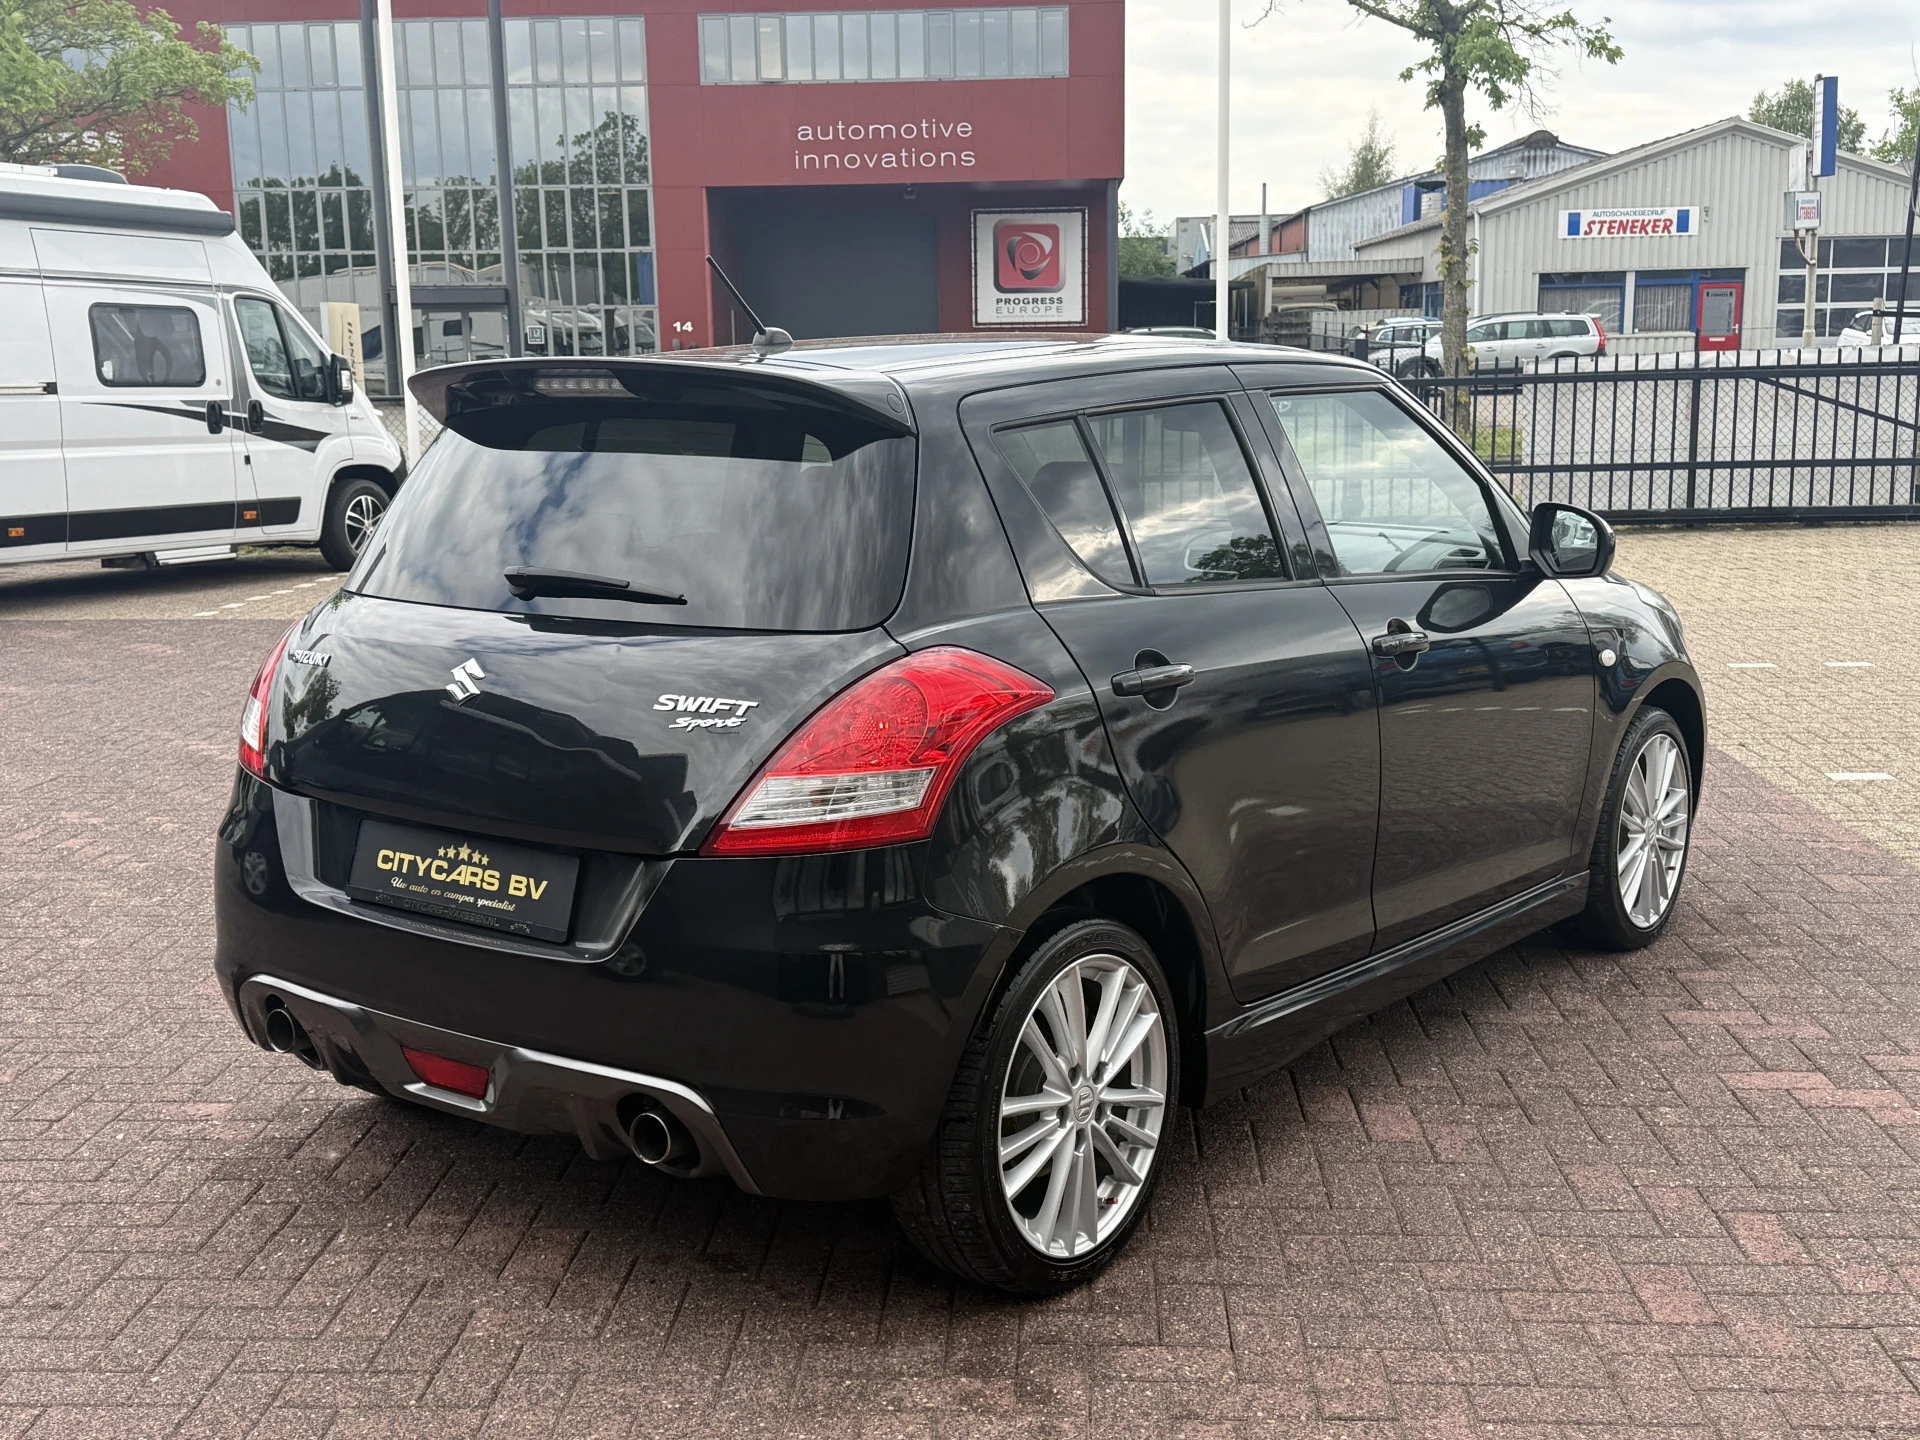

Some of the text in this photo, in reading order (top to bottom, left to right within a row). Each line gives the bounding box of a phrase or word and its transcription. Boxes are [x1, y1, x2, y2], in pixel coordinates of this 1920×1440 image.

[797, 118, 973, 141] automotive
[794, 147, 977, 170] innovations
[1583, 218, 1674, 236] STENEKER
[995, 296, 1064, 306] PROGRESS
[995, 305, 1064, 315] EUROPE
[672, 321, 694, 333] 14
[652, 694, 760, 717] SWIFT
[668, 716, 747, 733] Sport
[377, 849, 550, 901] CITYCARS BV
[409, 883, 429, 894] auto
[430, 888, 442, 897] en
[443, 891, 475, 904] camper
[476, 896, 517, 913] specialist
